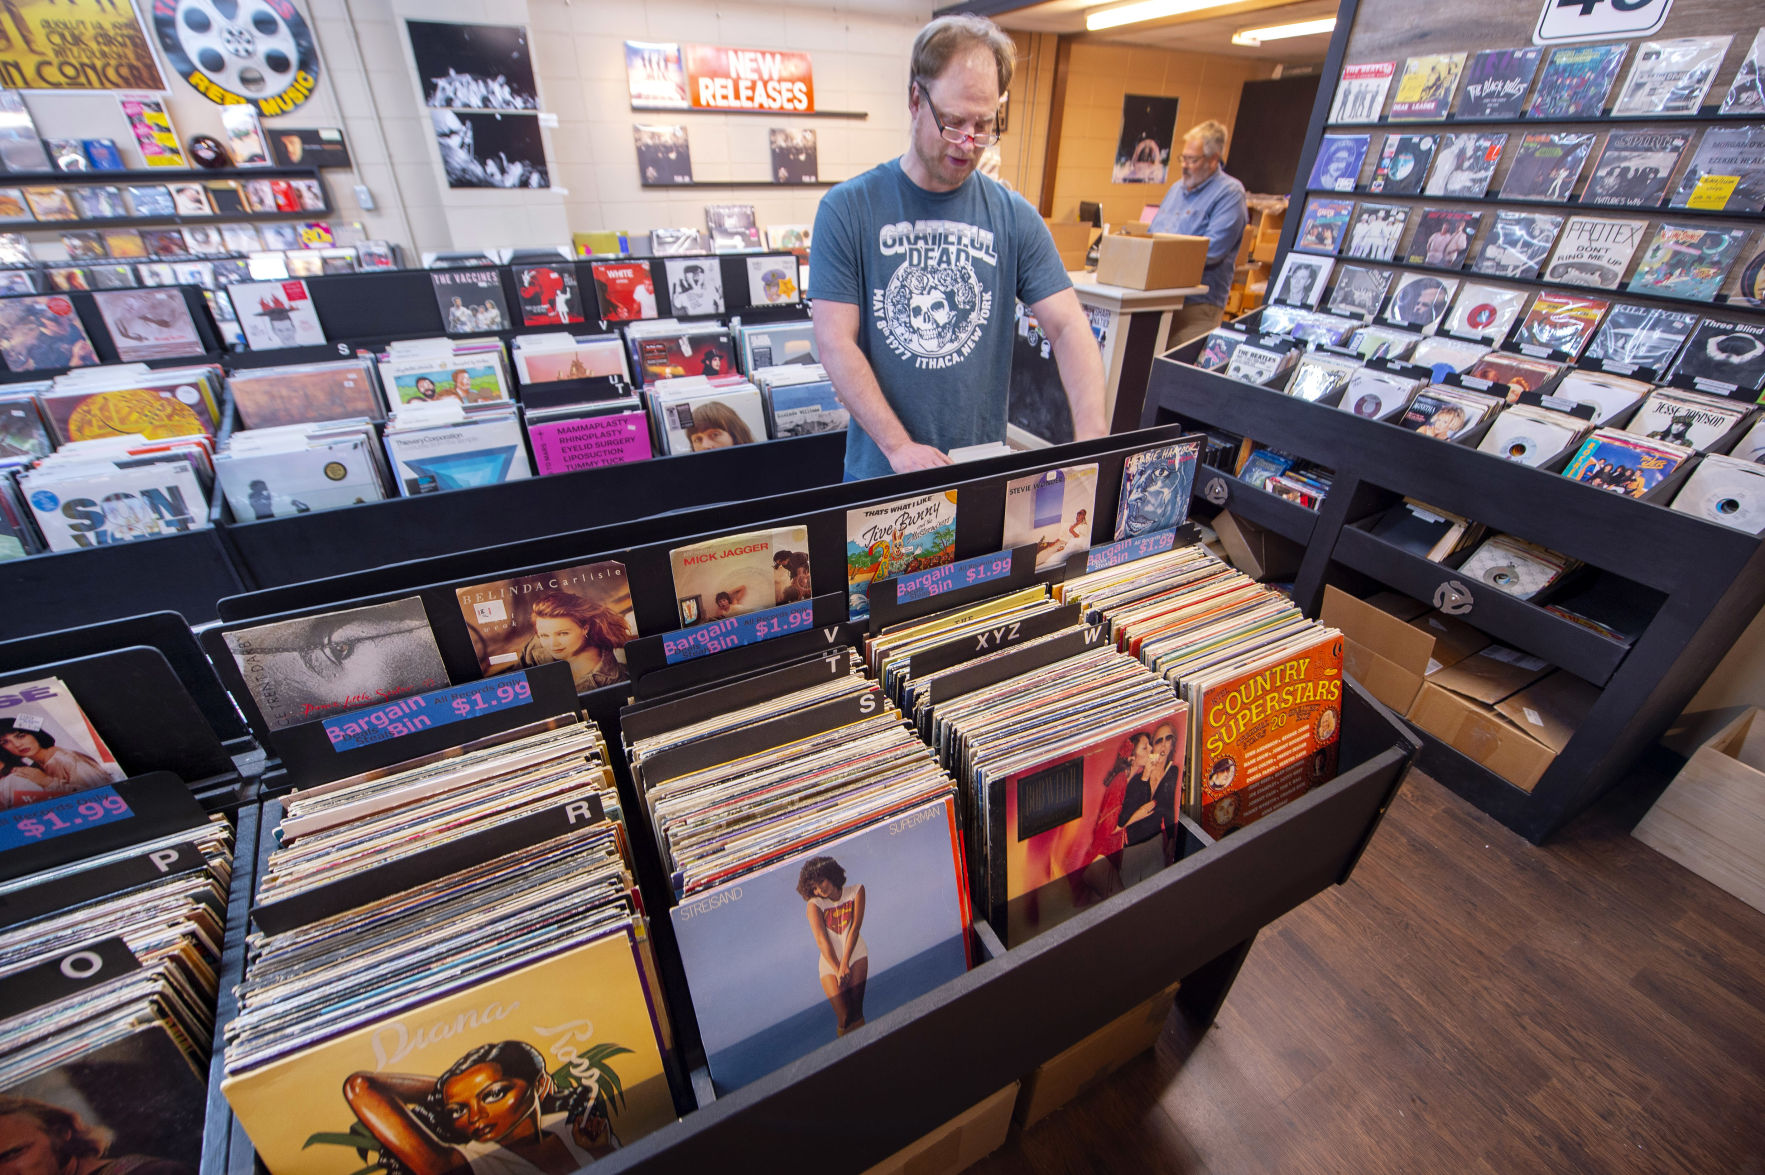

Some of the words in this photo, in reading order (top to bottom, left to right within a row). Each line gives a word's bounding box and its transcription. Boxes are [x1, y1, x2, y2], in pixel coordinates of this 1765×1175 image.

[728, 50, 782, 80] NEW
[258, 69, 315, 117] MUSIC
[698, 76, 808, 110] RELEASES
[879, 219, 998, 267] GRATEFUL
[1576, 245, 1611, 254] DON'T
[907, 246, 973, 268] DEAD
[1557, 253, 1585, 262] RING
[1587, 253, 1603, 262] ME
[1607, 257, 1622, 266] UP
[434, 274, 451, 285] THE
[454, 272, 498, 284] VACCINES
[607, 268, 634, 279] WHITE
[873, 289, 885, 318] MAY
[886, 334, 912, 361] 1977
[963, 326, 983, 357] NEW
[979, 290, 992, 325] YORK
[1704, 319, 1733, 330] Three
[1735, 324, 1765, 335] Blind
[337, 343, 351, 355] S
[557, 418, 628, 435] MAMMAPLASTY
[559, 429, 624, 444] RHINOPLASTY
[561, 443, 593, 454] EYELID
[594, 436, 636, 448] SURGERY
[563, 448, 624, 463] LIPOSUCTION
[565, 460, 598, 472] TUMMY
[601, 456, 625, 466] TUCK
[1009, 485, 1031, 496] STEVIE
[1033, 476, 1064, 490] WONDER
[62, 485, 191, 533] SON
[891, 504, 912, 514] WHAT
[916, 496, 933, 506] LIKE
[862, 524, 893, 549] Jive
[894, 502, 941, 532] Bunny
[684, 552, 717, 567] MICK
[720, 542, 769, 559] JAGGER
[1139, 534, 1175, 555] $1.99
[897, 564, 954, 597] Bargain
[966, 558, 1012, 583] $1.99
[463, 582, 545, 605] BELINDA
[548, 568, 622, 588] Carlisle
[929, 579, 953, 596] Bin
[755, 610, 814, 638] $1.99
[824, 626, 839, 643] V
[976, 622, 1021, 649] XYZ
[1084, 626, 1103, 645] W
[664, 618, 738, 656] Bargain
[709, 634, 738, 654] Bin
[826, 655, 840, 673] T
[434, 695, 448, 705] All
[451, 685, 495, 699] Records
[498, 679, 521, 690] Only
[452, 682, 530, 716] $1.99
[859, 694, 876, 713] S
[1209, 658, 1310, 728] COUNTRY
[326, 696, 427, 744] Bargain
[388, 714, 432, 738] Bin
[1206, 680, 1341, 758] SUPERSTARS
[1270, 713, 1287, 731] 20
[343, 727, 378, 742] Deals
[356, 731, 395, 745] Steals
[17, 796, 127, 838] $1.99
[565, 802, 591, 824] R
[889, 806, 942, 836] SUPERMAN
[149, 849, 180, 872] P
[681, 886, 744, 921] STREISAND
[60, 951, 103, 978] O
[371, 1001, 520, 1072] Diana
